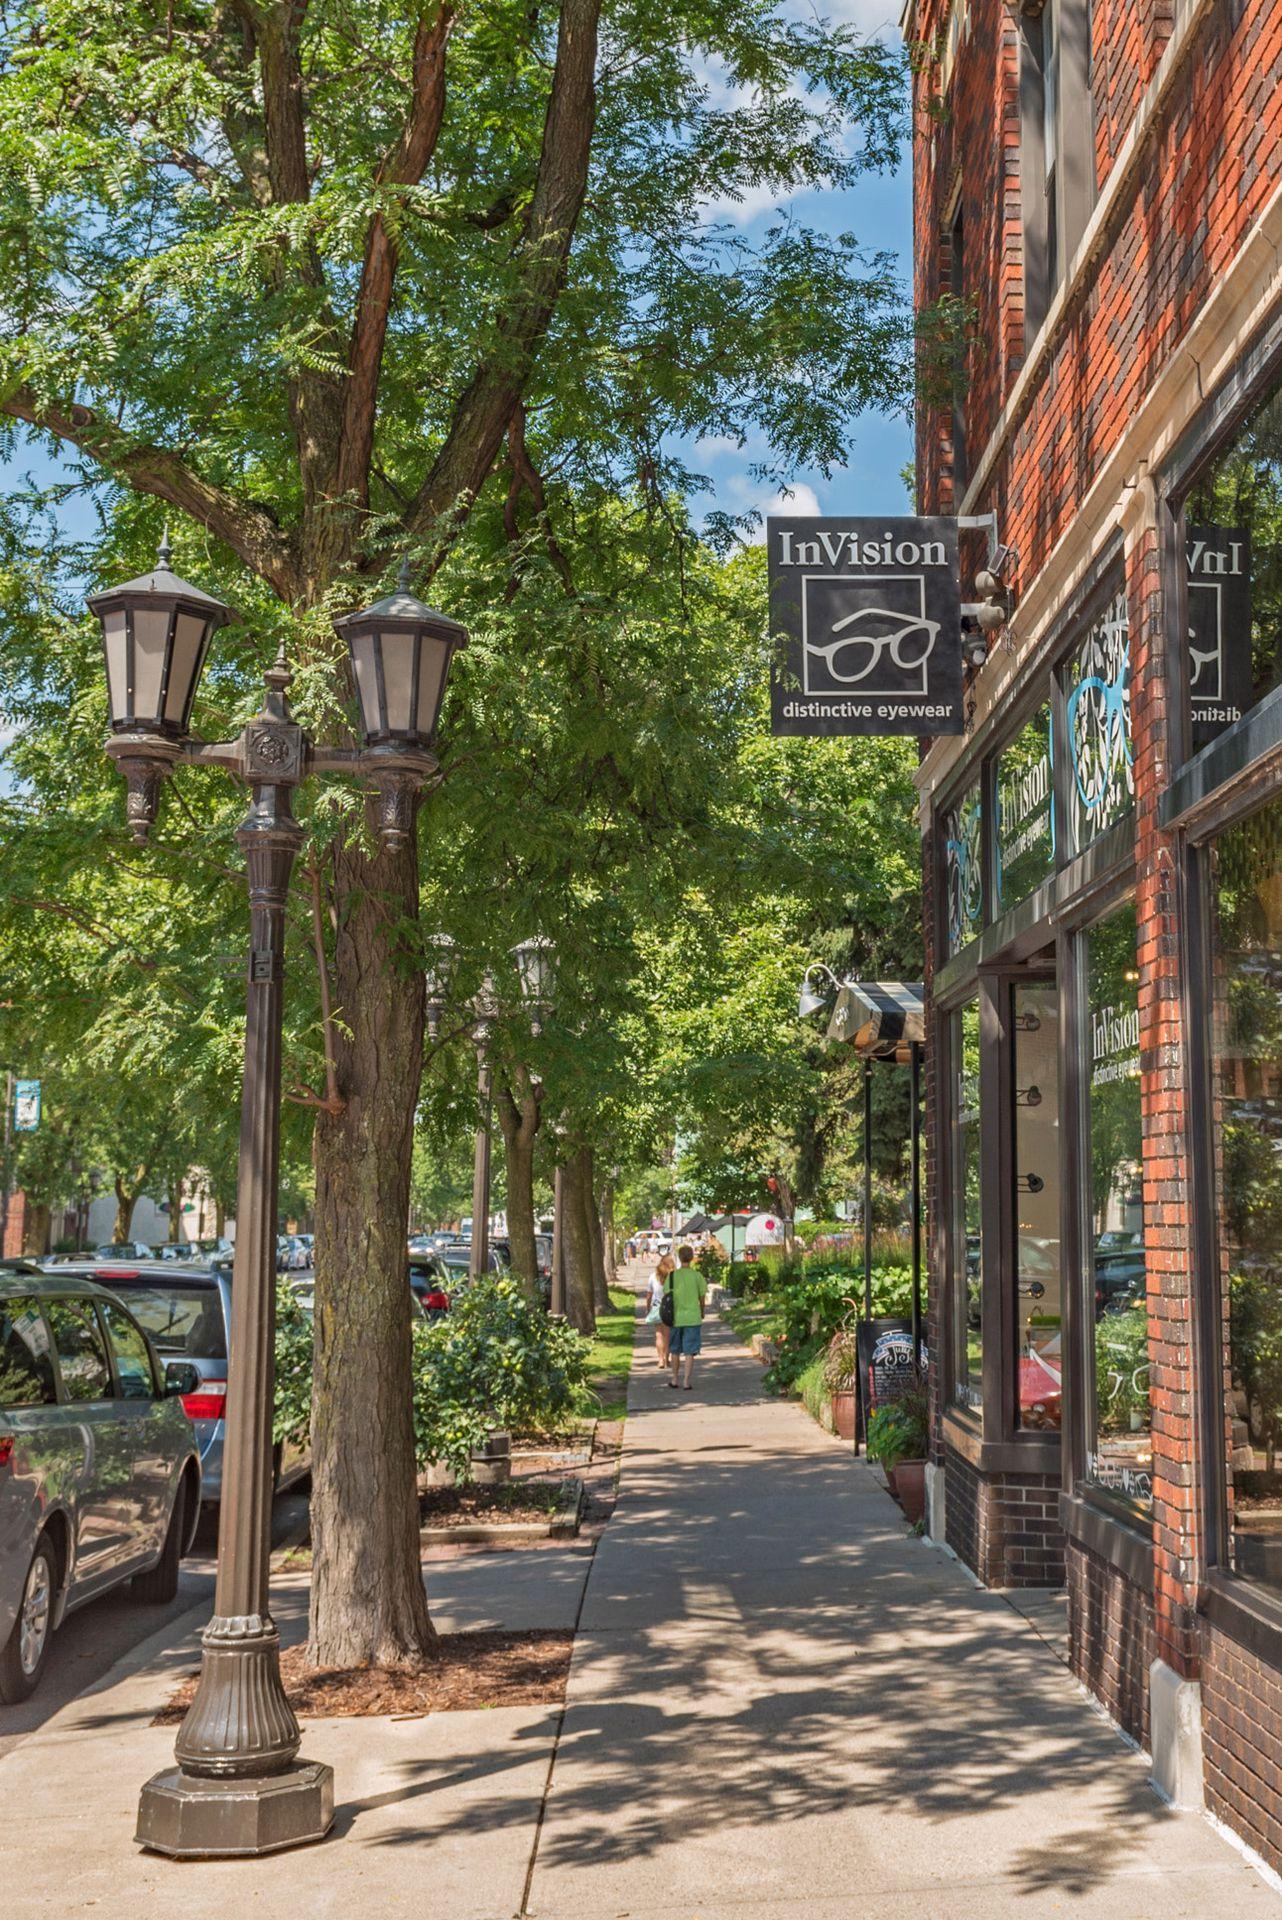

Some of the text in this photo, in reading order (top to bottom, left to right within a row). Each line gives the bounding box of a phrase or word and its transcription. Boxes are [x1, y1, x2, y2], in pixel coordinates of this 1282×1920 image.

[779, 531, 948, 566] InVision
[783, 702, 953, 720] distinctive eyewear
[1092, 1002, 1140, 1060] InVision
